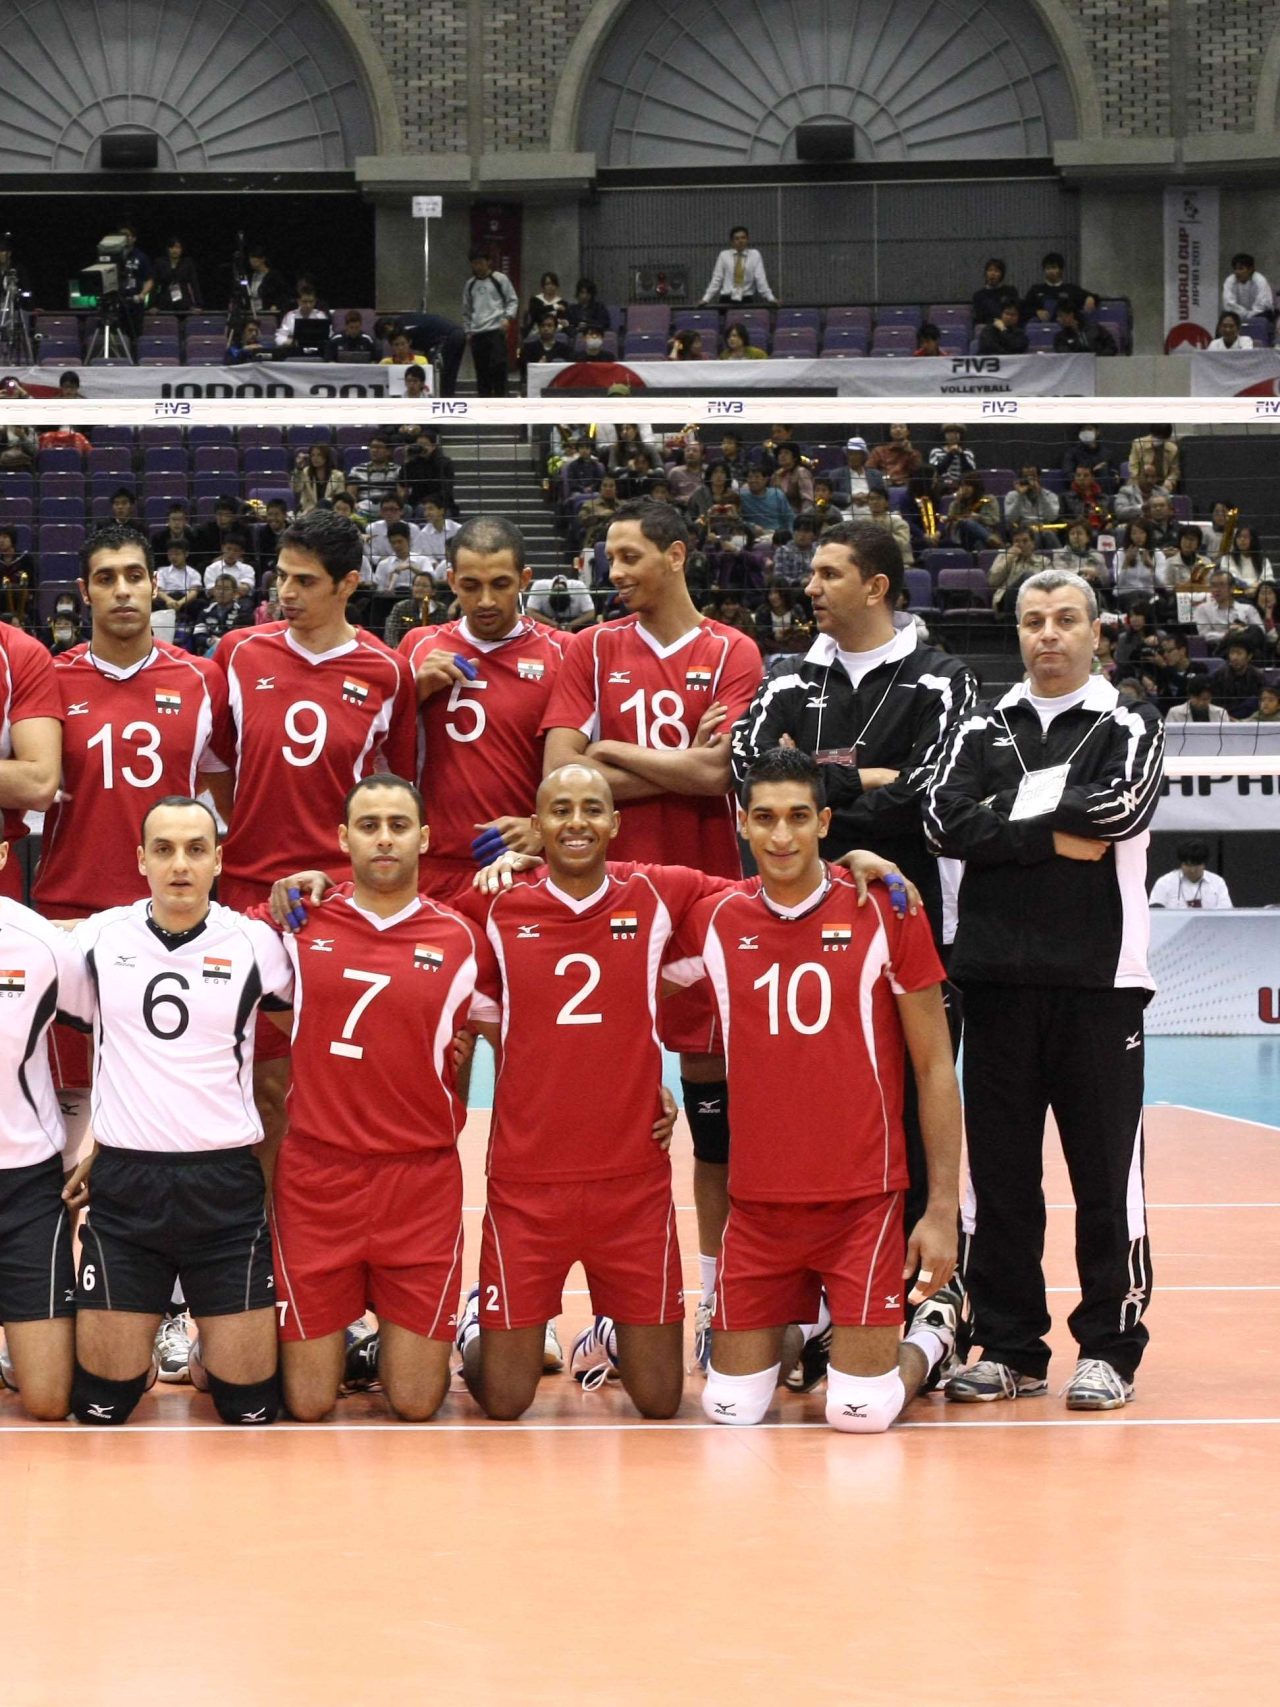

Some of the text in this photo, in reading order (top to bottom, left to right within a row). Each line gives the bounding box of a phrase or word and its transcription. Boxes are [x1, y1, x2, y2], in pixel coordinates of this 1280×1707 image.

[1178, 227, 1190, 320] WORLD CUP
[940, 384, 1012, 395] VOLLEYBALL
[951, 357, 1000, 373] FIVB
[155, 402, 191, 415] FIVB
[431, 402, 468, 414] FIVB
[707, 401, 743, 413] FIVB
[982, 401, 1018, 413] FIVB
[1256, 401, 1280, 413] FIV
[282, 700, 328, 767] 9
[445, 680, 488, 743] 5
[620, 688, 691, 750] 18
[87, 721, 163, 789] 13
[413, 961, 439, 972] EGY
[823, 944, 848, 952] EGY
[143, 972, 190, 1041] 6
[341, 968, 391, 1040] 7
[554, 953, 602, 1025] 2
[753, 962, 832, 1035] 10
[83, 1264, 96, 1291] 6
[486, 1284, 499, 1311] 2
[275, 1301, 289, 1327] 7
